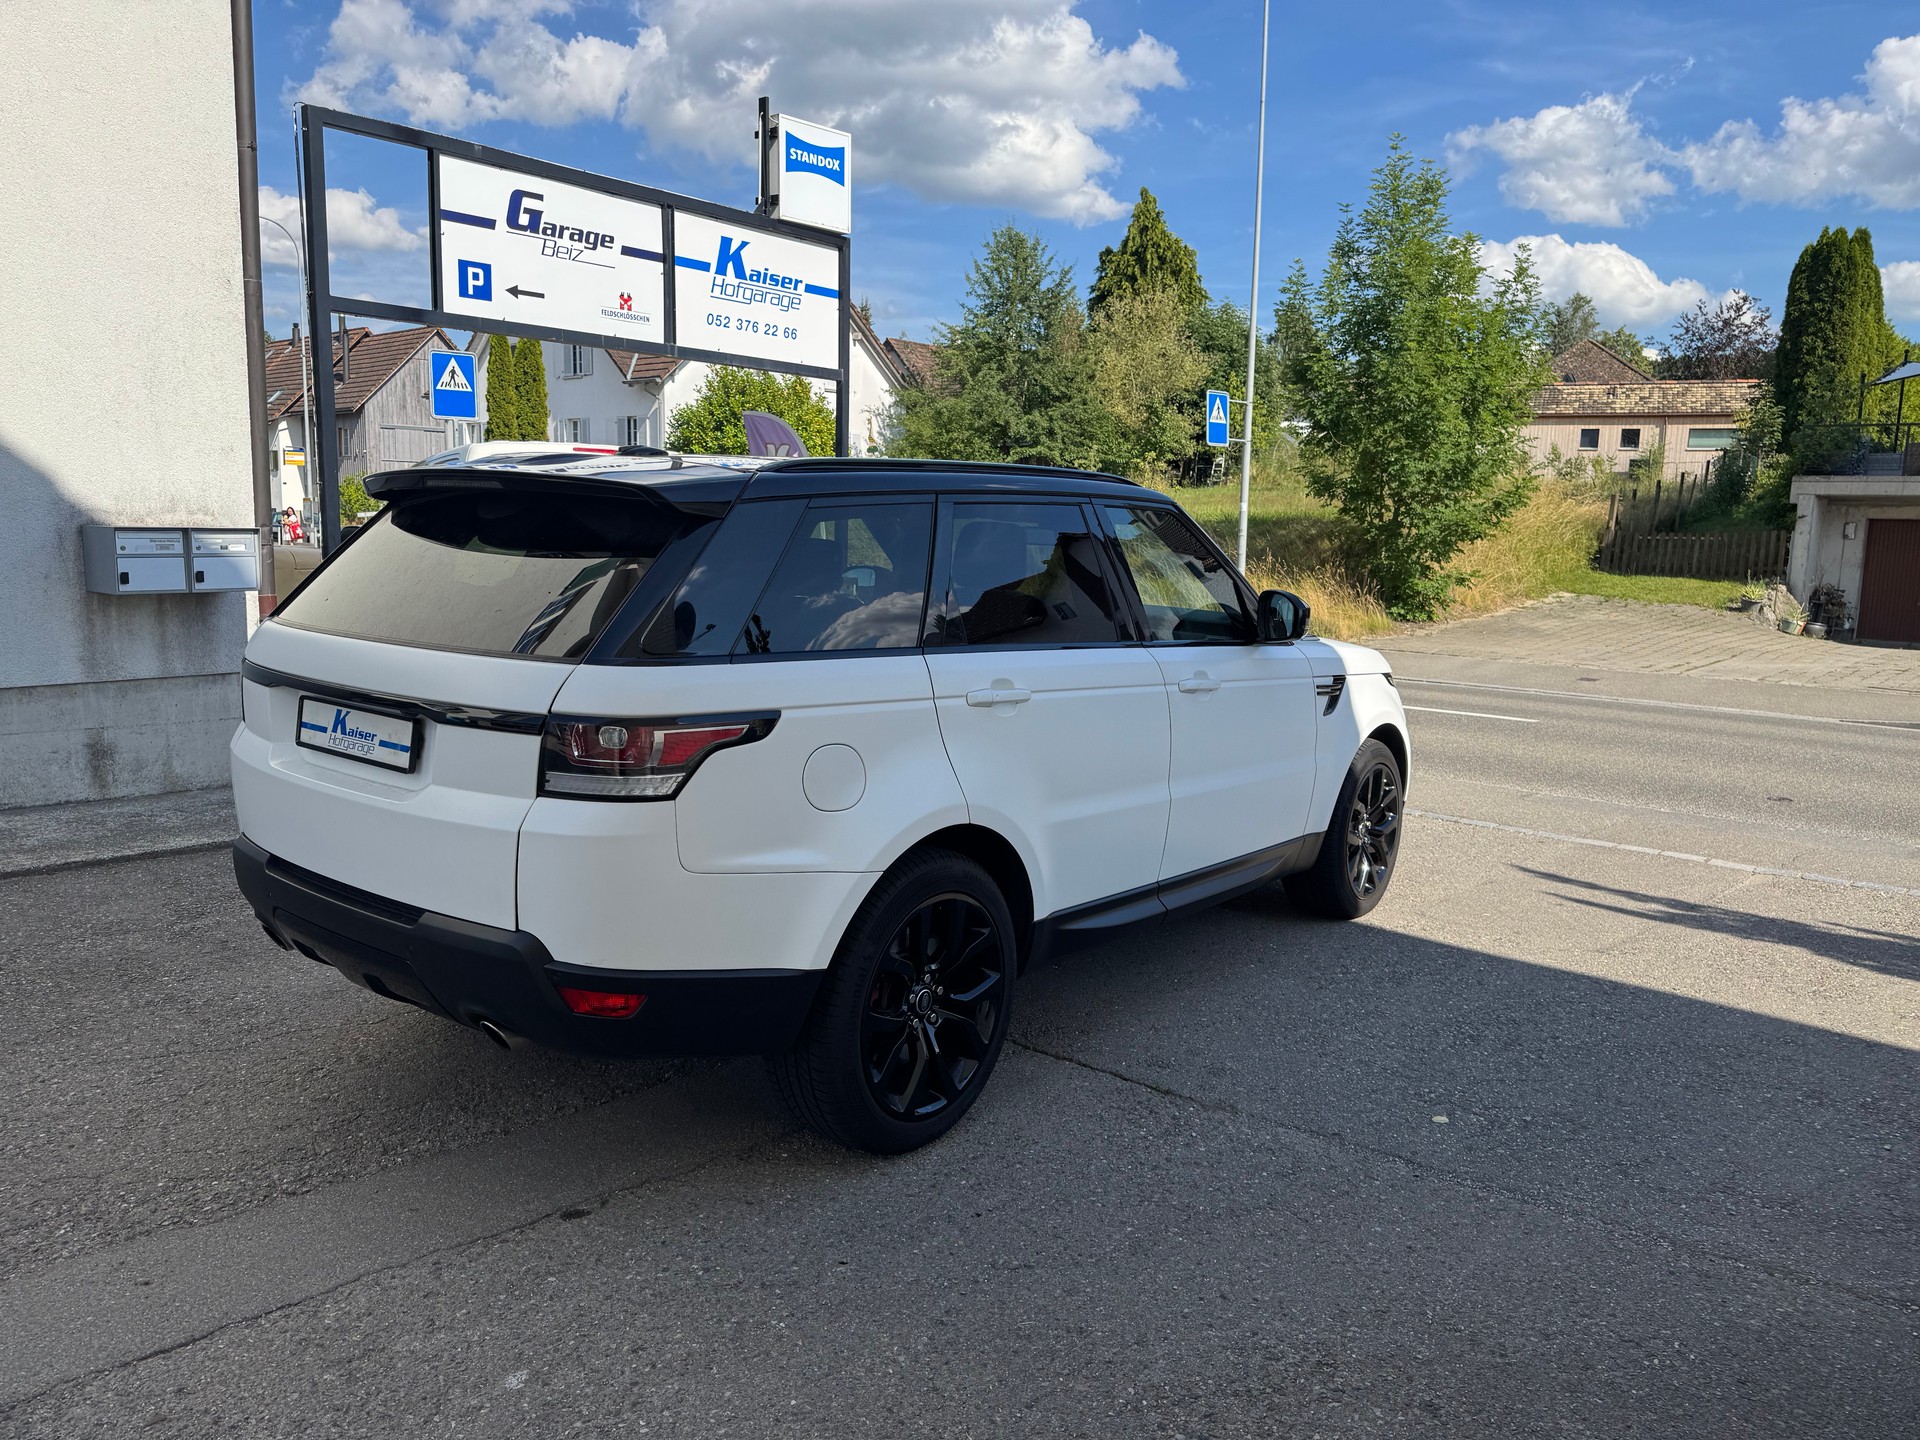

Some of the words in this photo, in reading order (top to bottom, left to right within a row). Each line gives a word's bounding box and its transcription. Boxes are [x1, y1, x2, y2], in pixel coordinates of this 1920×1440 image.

[790, 148, 841, 171] STANDOX
[506, 189, 615, 251] Garage
[541, 239, 584, 261] Beiz
[714, 235, 803, 291] Kaiser
[467, 266, 485, 295] P
[710, 276, 801, 312] Hofgarage
[601, 308, 650, 322] FELDSCHLÖSSCHEN
[706, 313, 731, 328] 052
[736, 318, 759, 333] 376
[764, 323, 778, 337] 22
[783, 327, 798, 340] 66
[331, 708, 377, 742] Kaiser
[328, 733, 375, 756] Hofgarage
